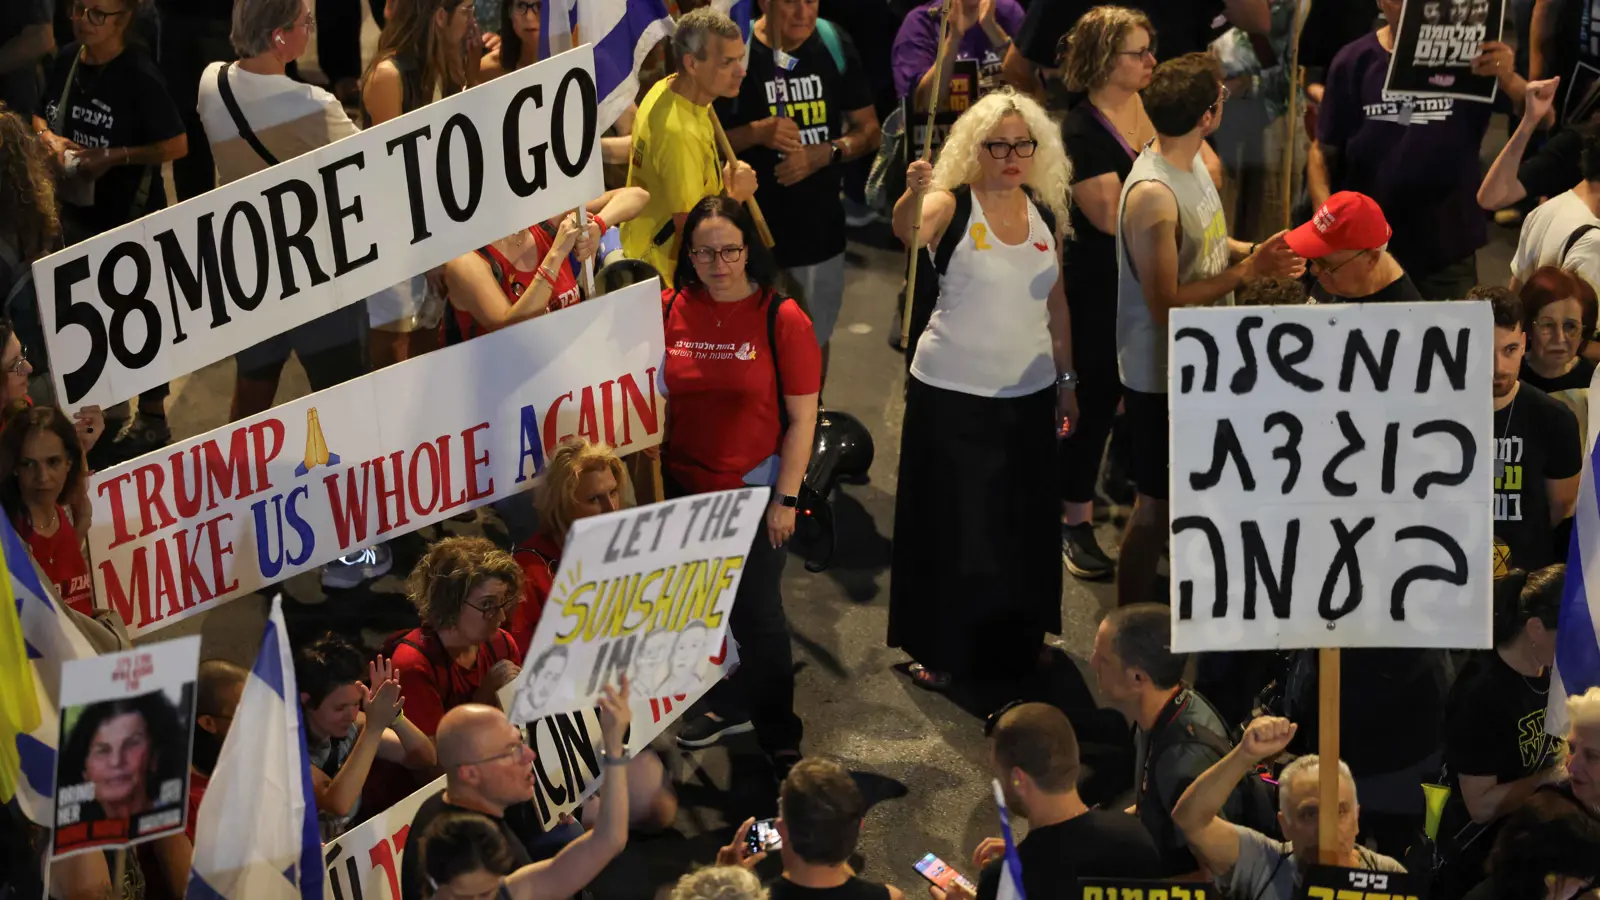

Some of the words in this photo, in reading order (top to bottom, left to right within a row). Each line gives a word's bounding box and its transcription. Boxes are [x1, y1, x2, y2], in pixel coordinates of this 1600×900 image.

[1414, 38, 1484, 60] שלהם
[1418, 20, 1487, 41] למלחמה
[72, 105, 114, 129] ניצבים
[788, 74, 824, 102] למה
[1362, 102, 1398, 116] ביחד
[53, 241, 162, 404] 58
[154, 151, 378, 345] MORE
[387, 113, 484, 245] TO
[503, 67, 598, 197] GO
[1175, 316, 1470, 395] ממשלה
[98, 418, 285, 549] TRUMP
[1189, 410, 1477, 499] בוגדת
[99, 513, 239, 628] MAKE
[251, 485, 315, 578] US
[323, 422, 494, 550] WHOLE
[515, 367, 658, 483] AGAIN
[602, 504, 675, 564] LET
[680, 491, 752, 549] THE
[554, 555, 744, 645] SUNSHINE
[1171, 515, 1469, 621] בעמה
[585, 635, 637, 697] IN
[1349, 871, 1389, 890] ביבי
